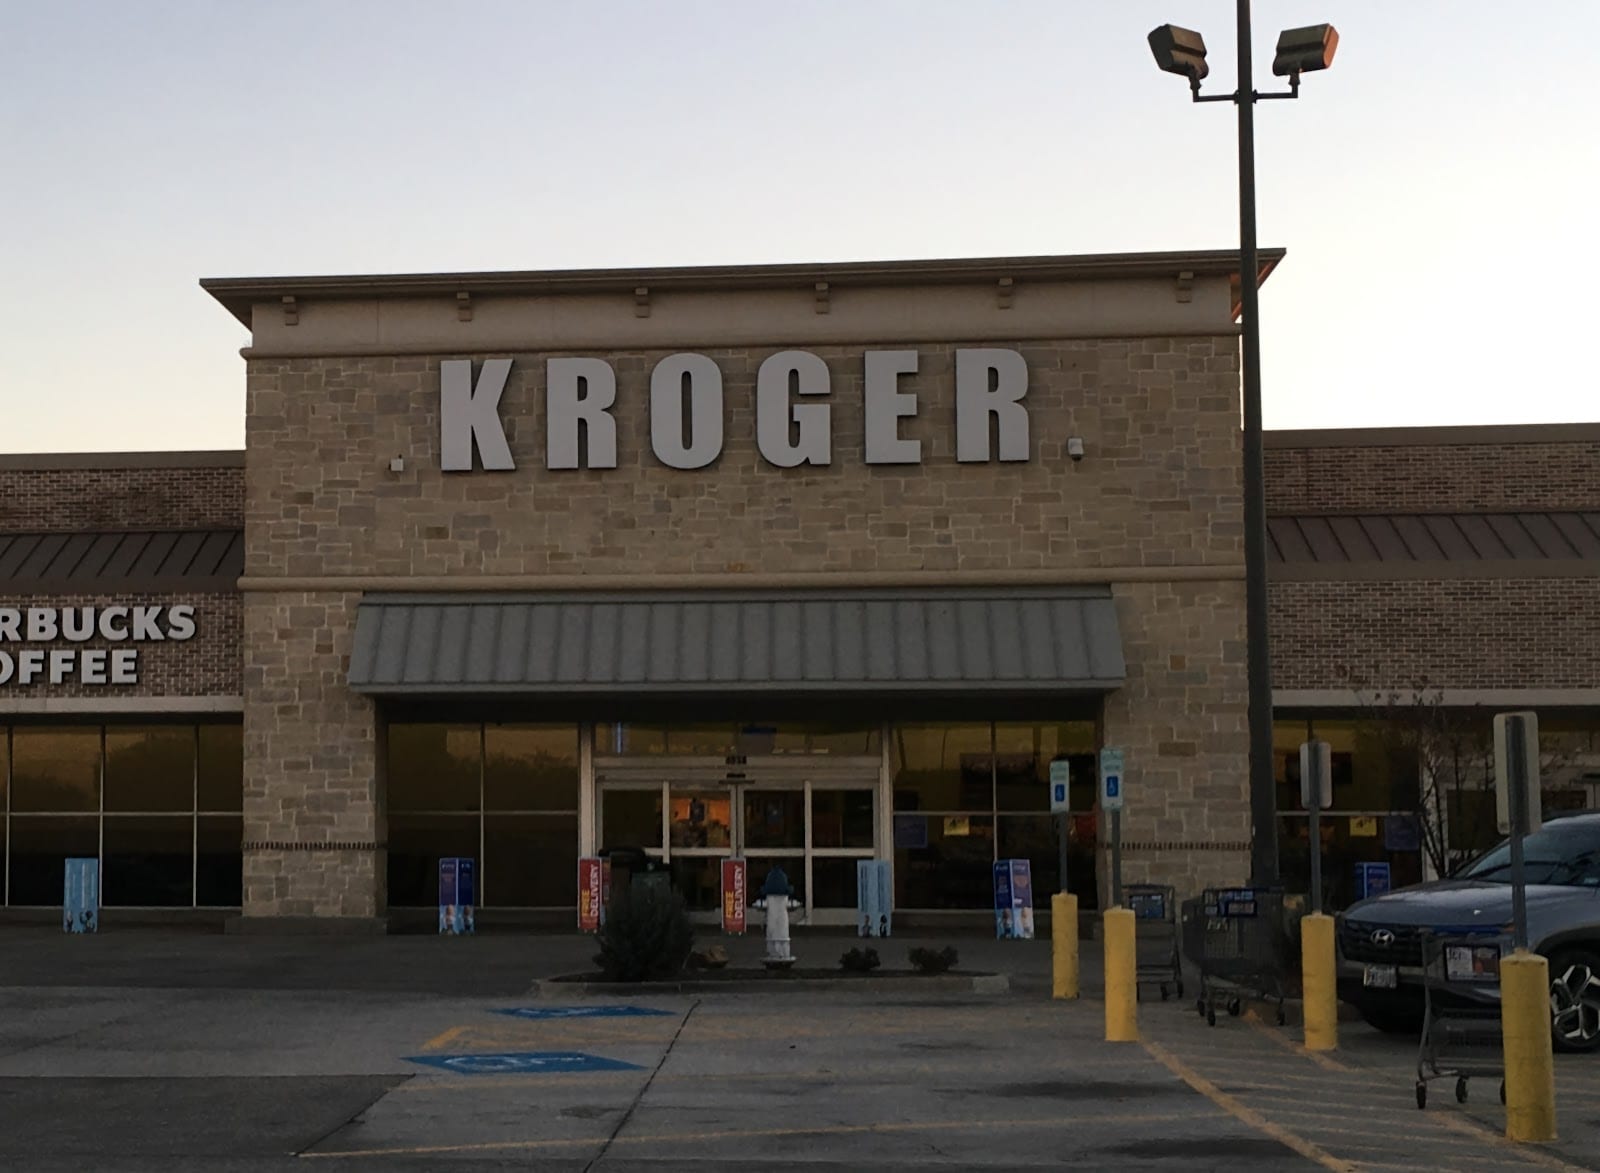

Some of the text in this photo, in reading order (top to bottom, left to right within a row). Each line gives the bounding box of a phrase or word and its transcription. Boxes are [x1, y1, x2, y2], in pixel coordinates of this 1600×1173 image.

[440, 348, 1030, 471] KROGER
[581, 889, 590, 917] FREE
[590, 864, 599, 917] DELIVERY
[725, 890, 734, 919] FREE
[734, 865, 744, 919] DELIVERY
